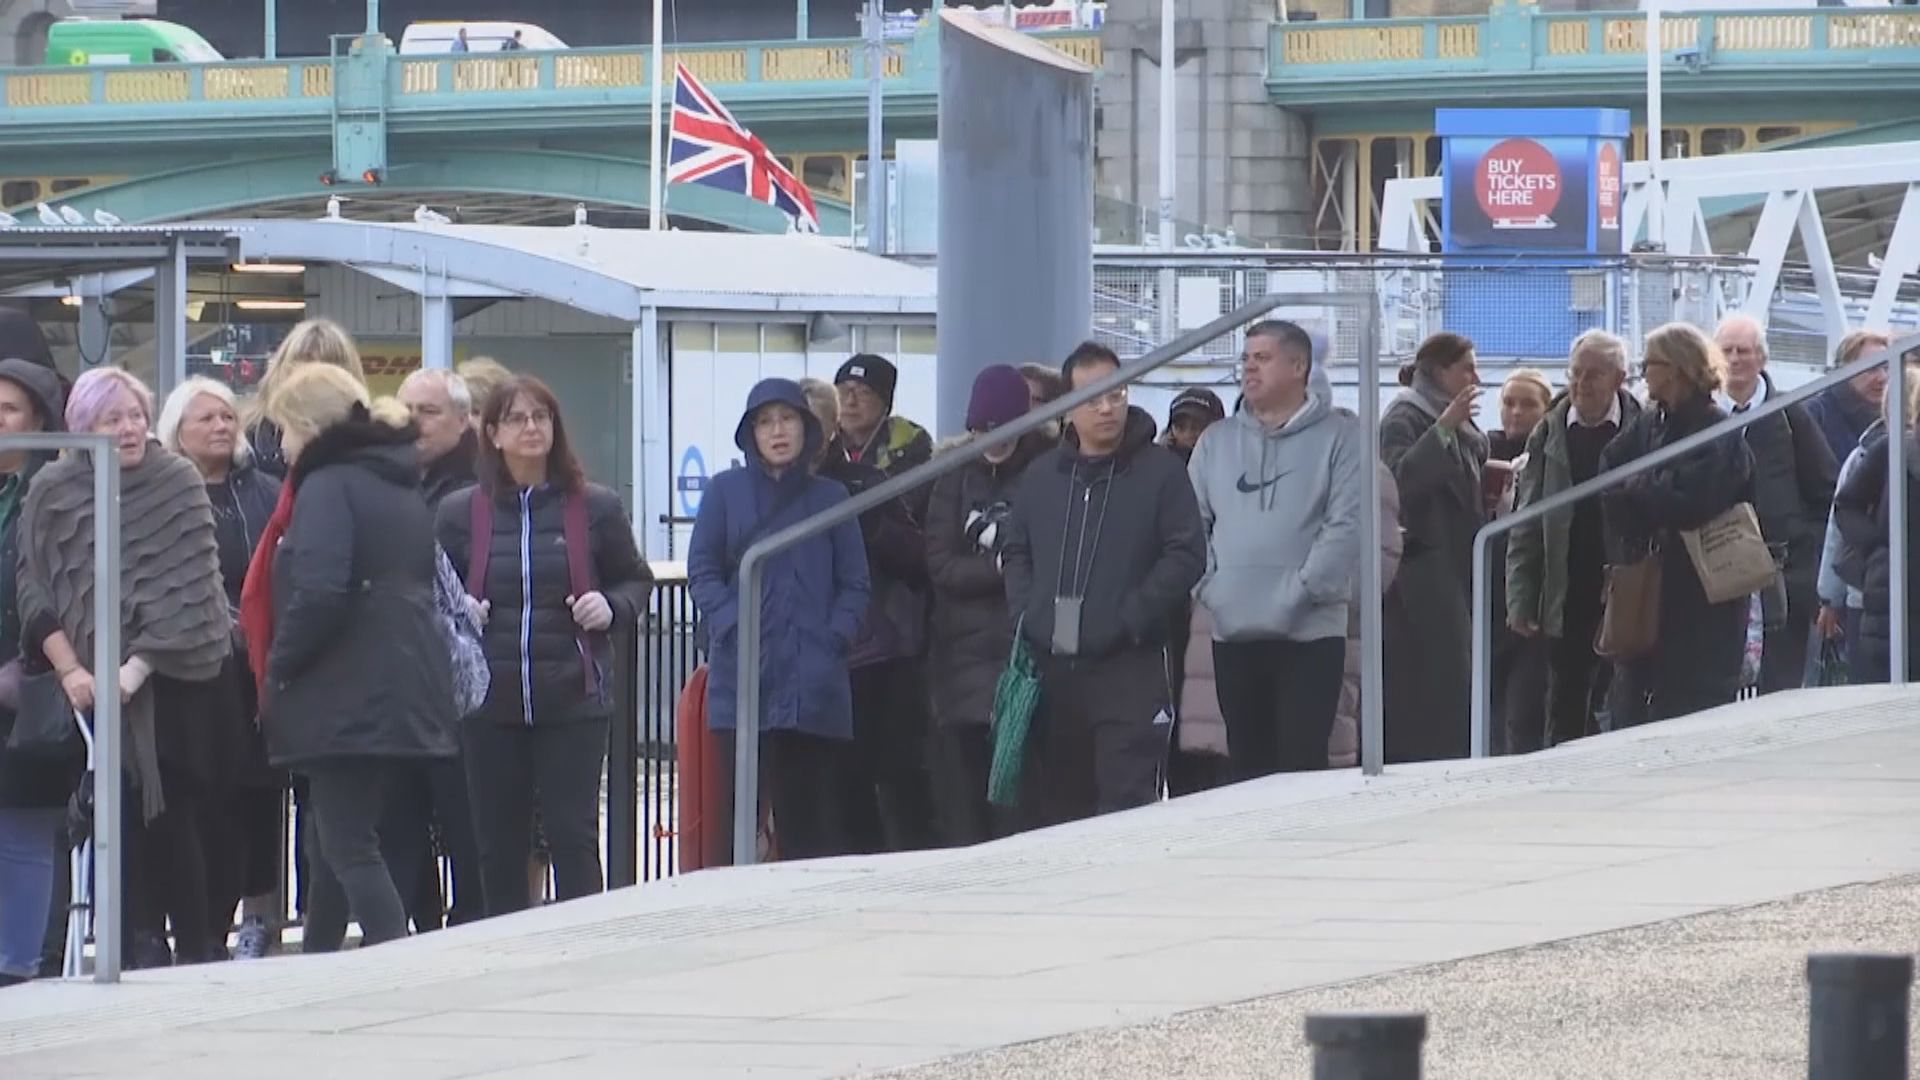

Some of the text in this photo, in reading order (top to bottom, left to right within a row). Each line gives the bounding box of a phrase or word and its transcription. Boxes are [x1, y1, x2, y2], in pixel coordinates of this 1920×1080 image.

[1487, 159, 1523, 173] BUY
[1487, 174, 1556, 190] TICKETS
[1487, 190, 1533, 205] HERE
[361, 355, 422, 375] DH
